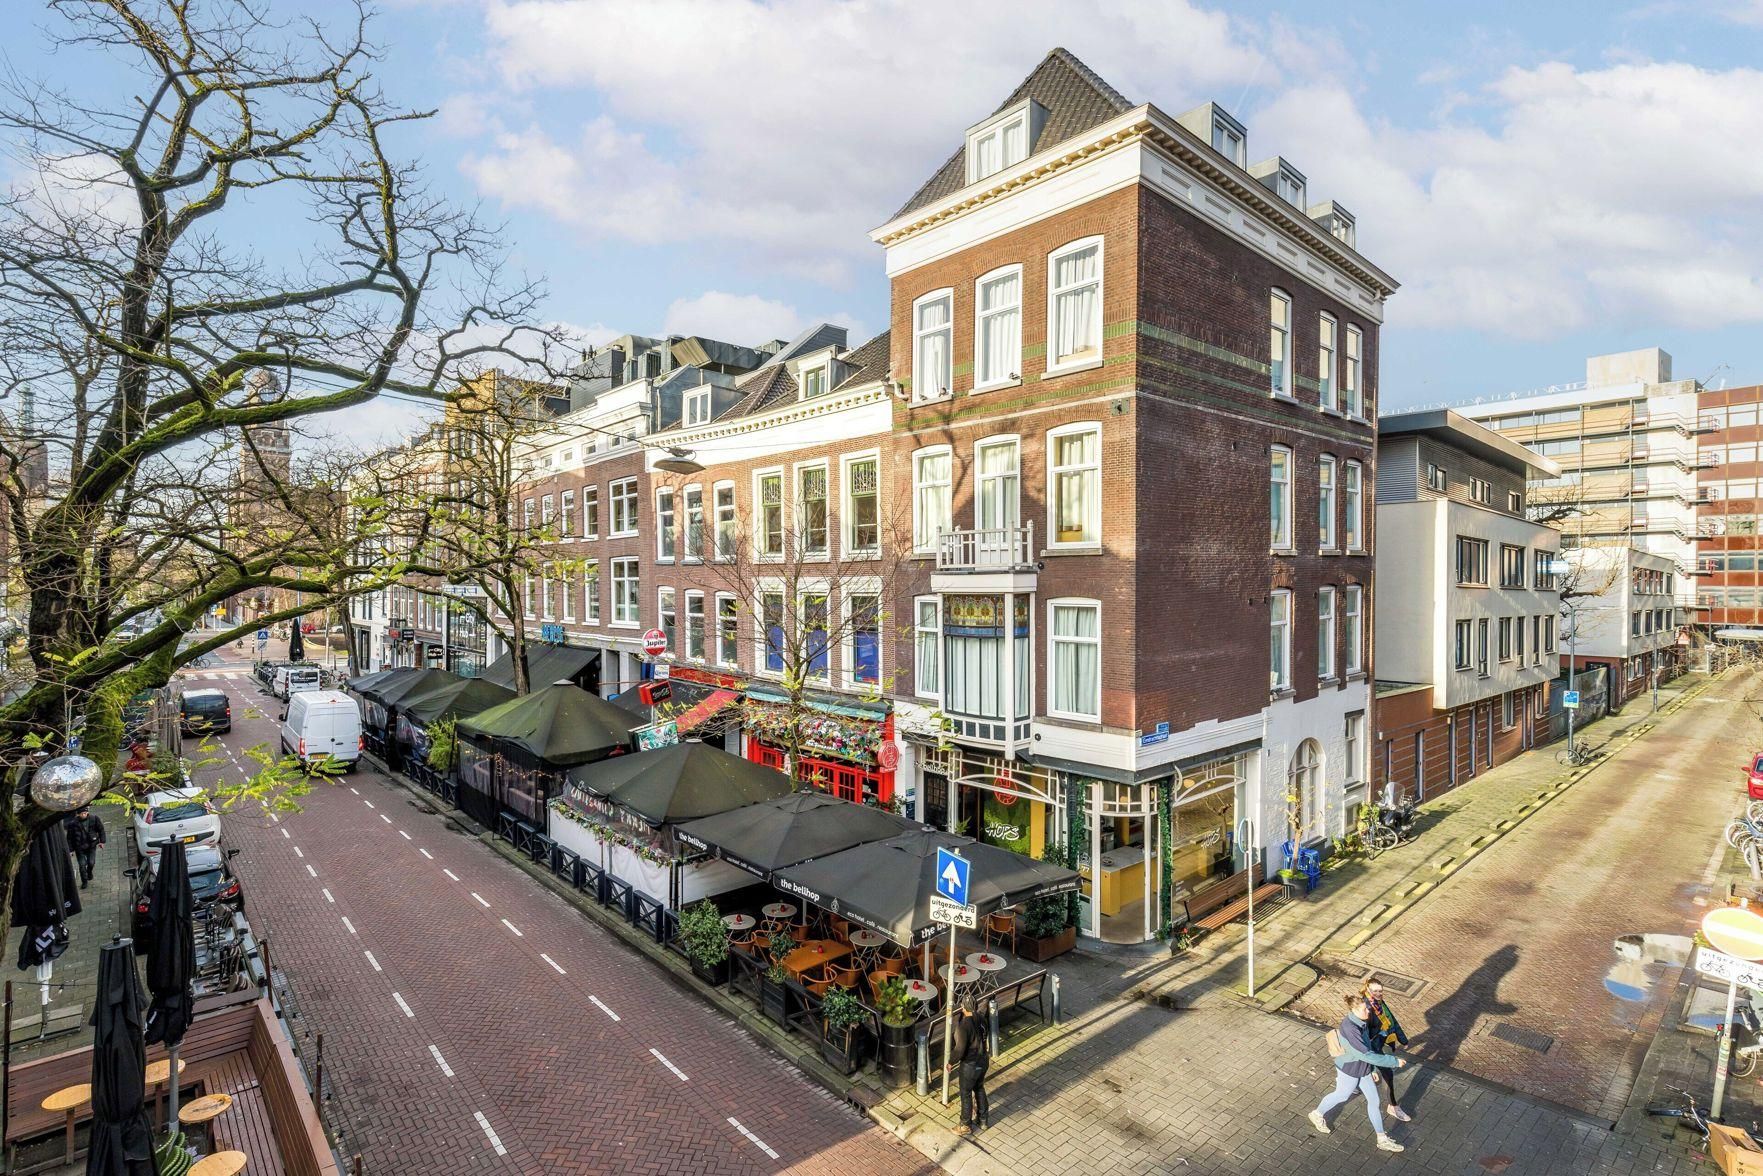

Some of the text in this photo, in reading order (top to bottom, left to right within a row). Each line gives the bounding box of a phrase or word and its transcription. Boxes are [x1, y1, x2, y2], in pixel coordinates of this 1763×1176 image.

[646, 639, 666, 648] Jupiler
[985, 821, 1020, 841] HOPS
[679, 832, 708, 851] the bellhop
[780, 879, 820, 902] the bellhop
[921, 926, 935, 939] the
